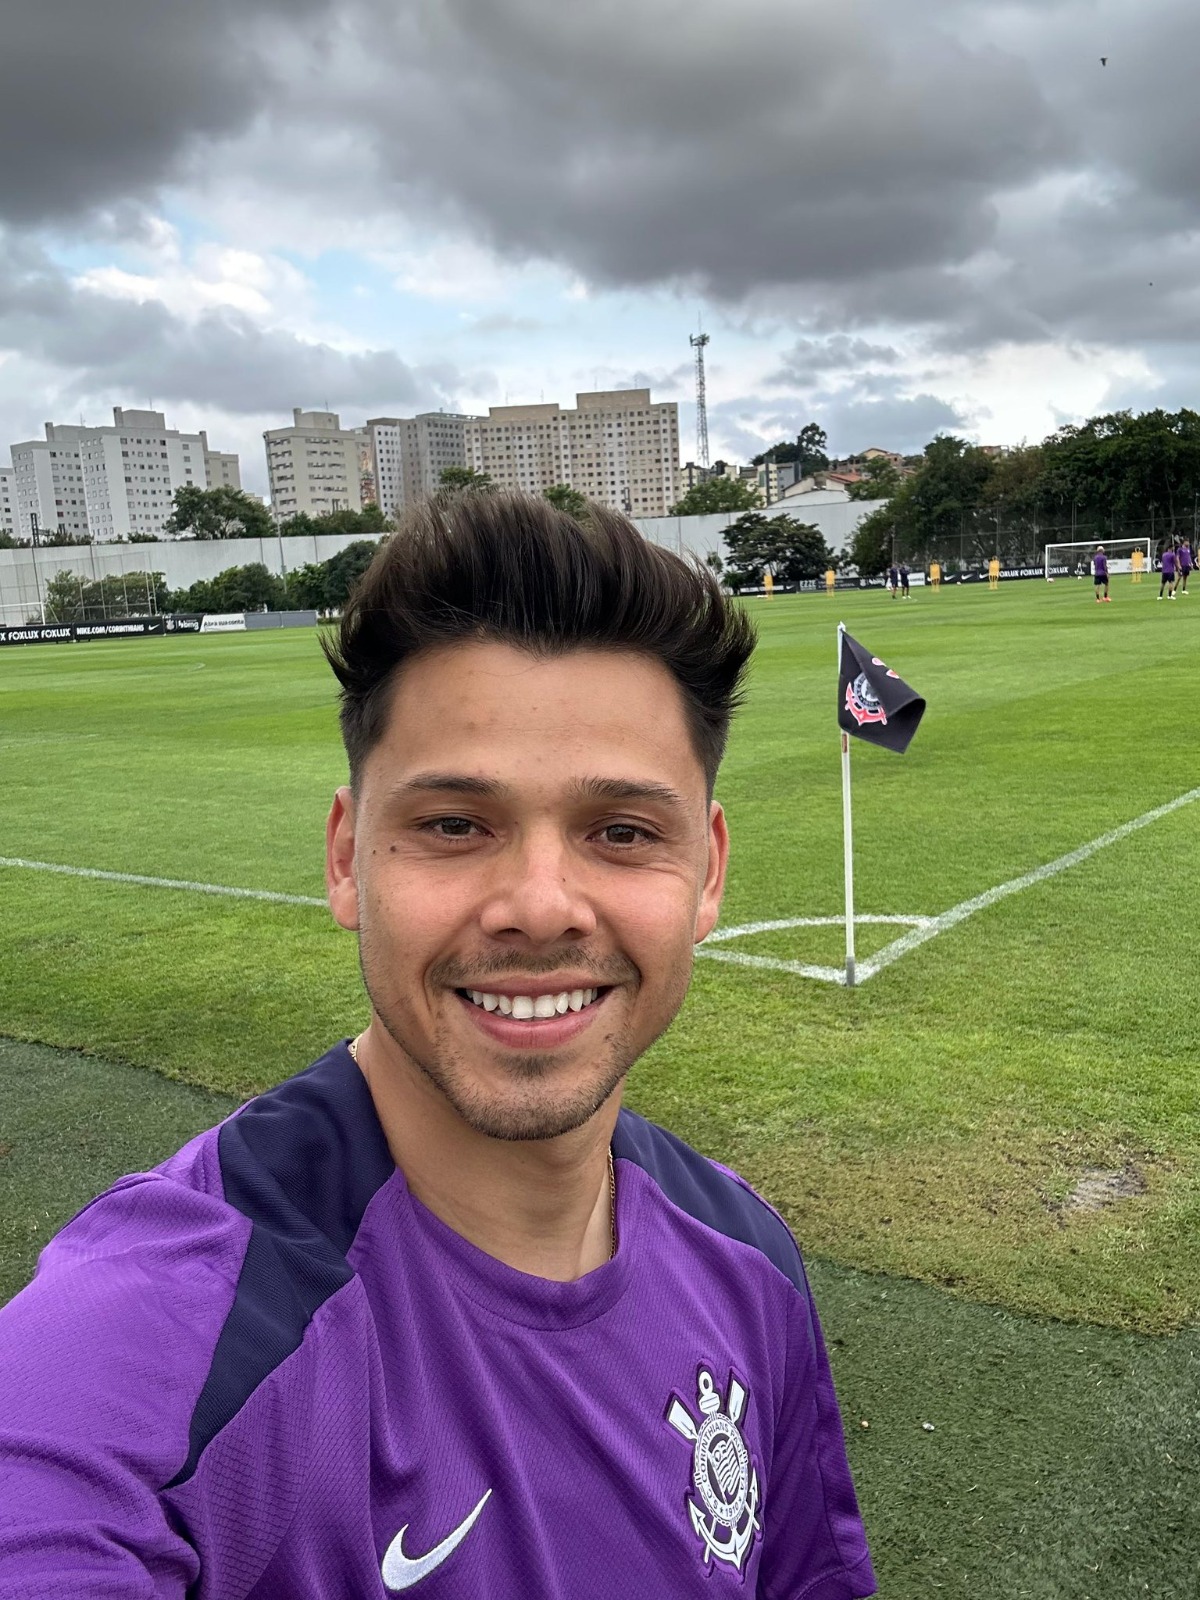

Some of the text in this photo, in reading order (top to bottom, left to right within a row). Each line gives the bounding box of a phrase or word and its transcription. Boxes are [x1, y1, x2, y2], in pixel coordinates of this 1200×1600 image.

[999, 569, 1019, 577] OXLUX
[1048, 566, 1069, 574] OXLUX
[8, 631, 39, 641] FOXLUX
[41, 628, 71, 638] FOXLUX
[700, 1421, 729, 1482] CORINTHIANS
[725, 1502, 738, 1517] 1910
